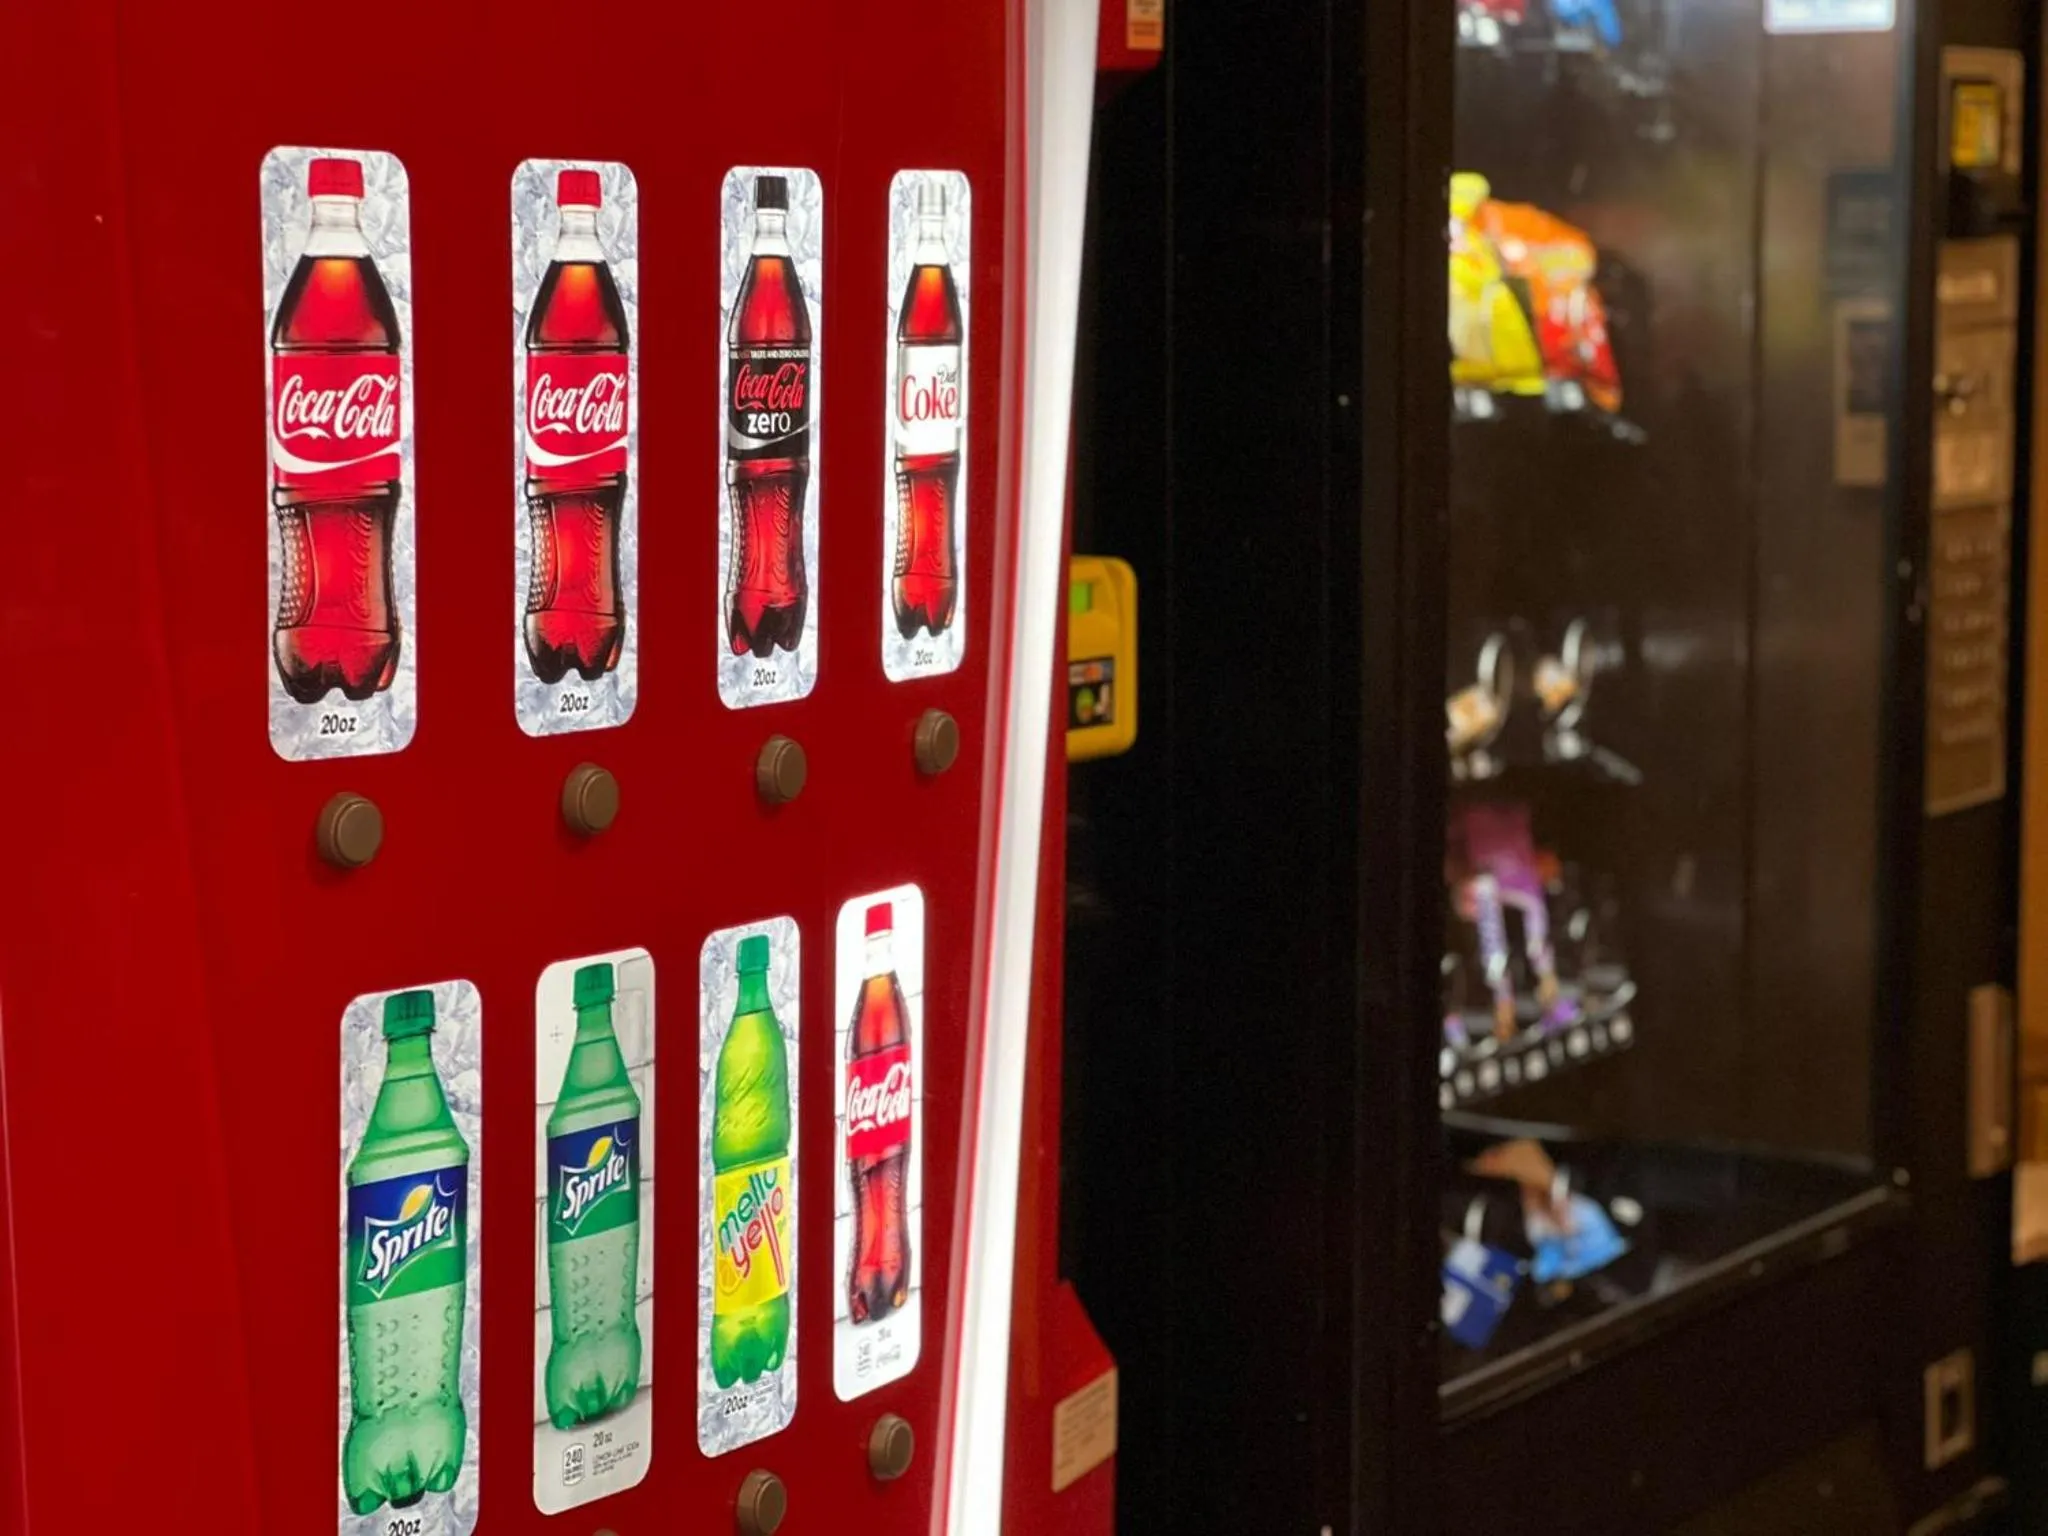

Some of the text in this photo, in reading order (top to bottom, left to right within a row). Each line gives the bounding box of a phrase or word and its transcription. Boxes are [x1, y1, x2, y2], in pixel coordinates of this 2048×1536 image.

[278, 374, 398, 440] Coca-Cola
[530, 373, 627, 434] Coca-Cola
[735, 362, 806, 411] Coca-Cola
[901, 374, 957, 422] Coke
[748, 412, 791, 433] zero
[559, 693, 590, 713] 20oz
[753, 668, 777, 687] 20oz
[320, 714, 357, 735] 20oz
[846, 1062, 911, 1137] Coca-Cola
[562, 1147, 625, 1220] Sprite
[718, 1167, 777, 1254] mello
[366, 1198, 449, 1280] Sprite
[731, 1186, 785, 1287] yello
[565, 1448, 583, 1467] 240
